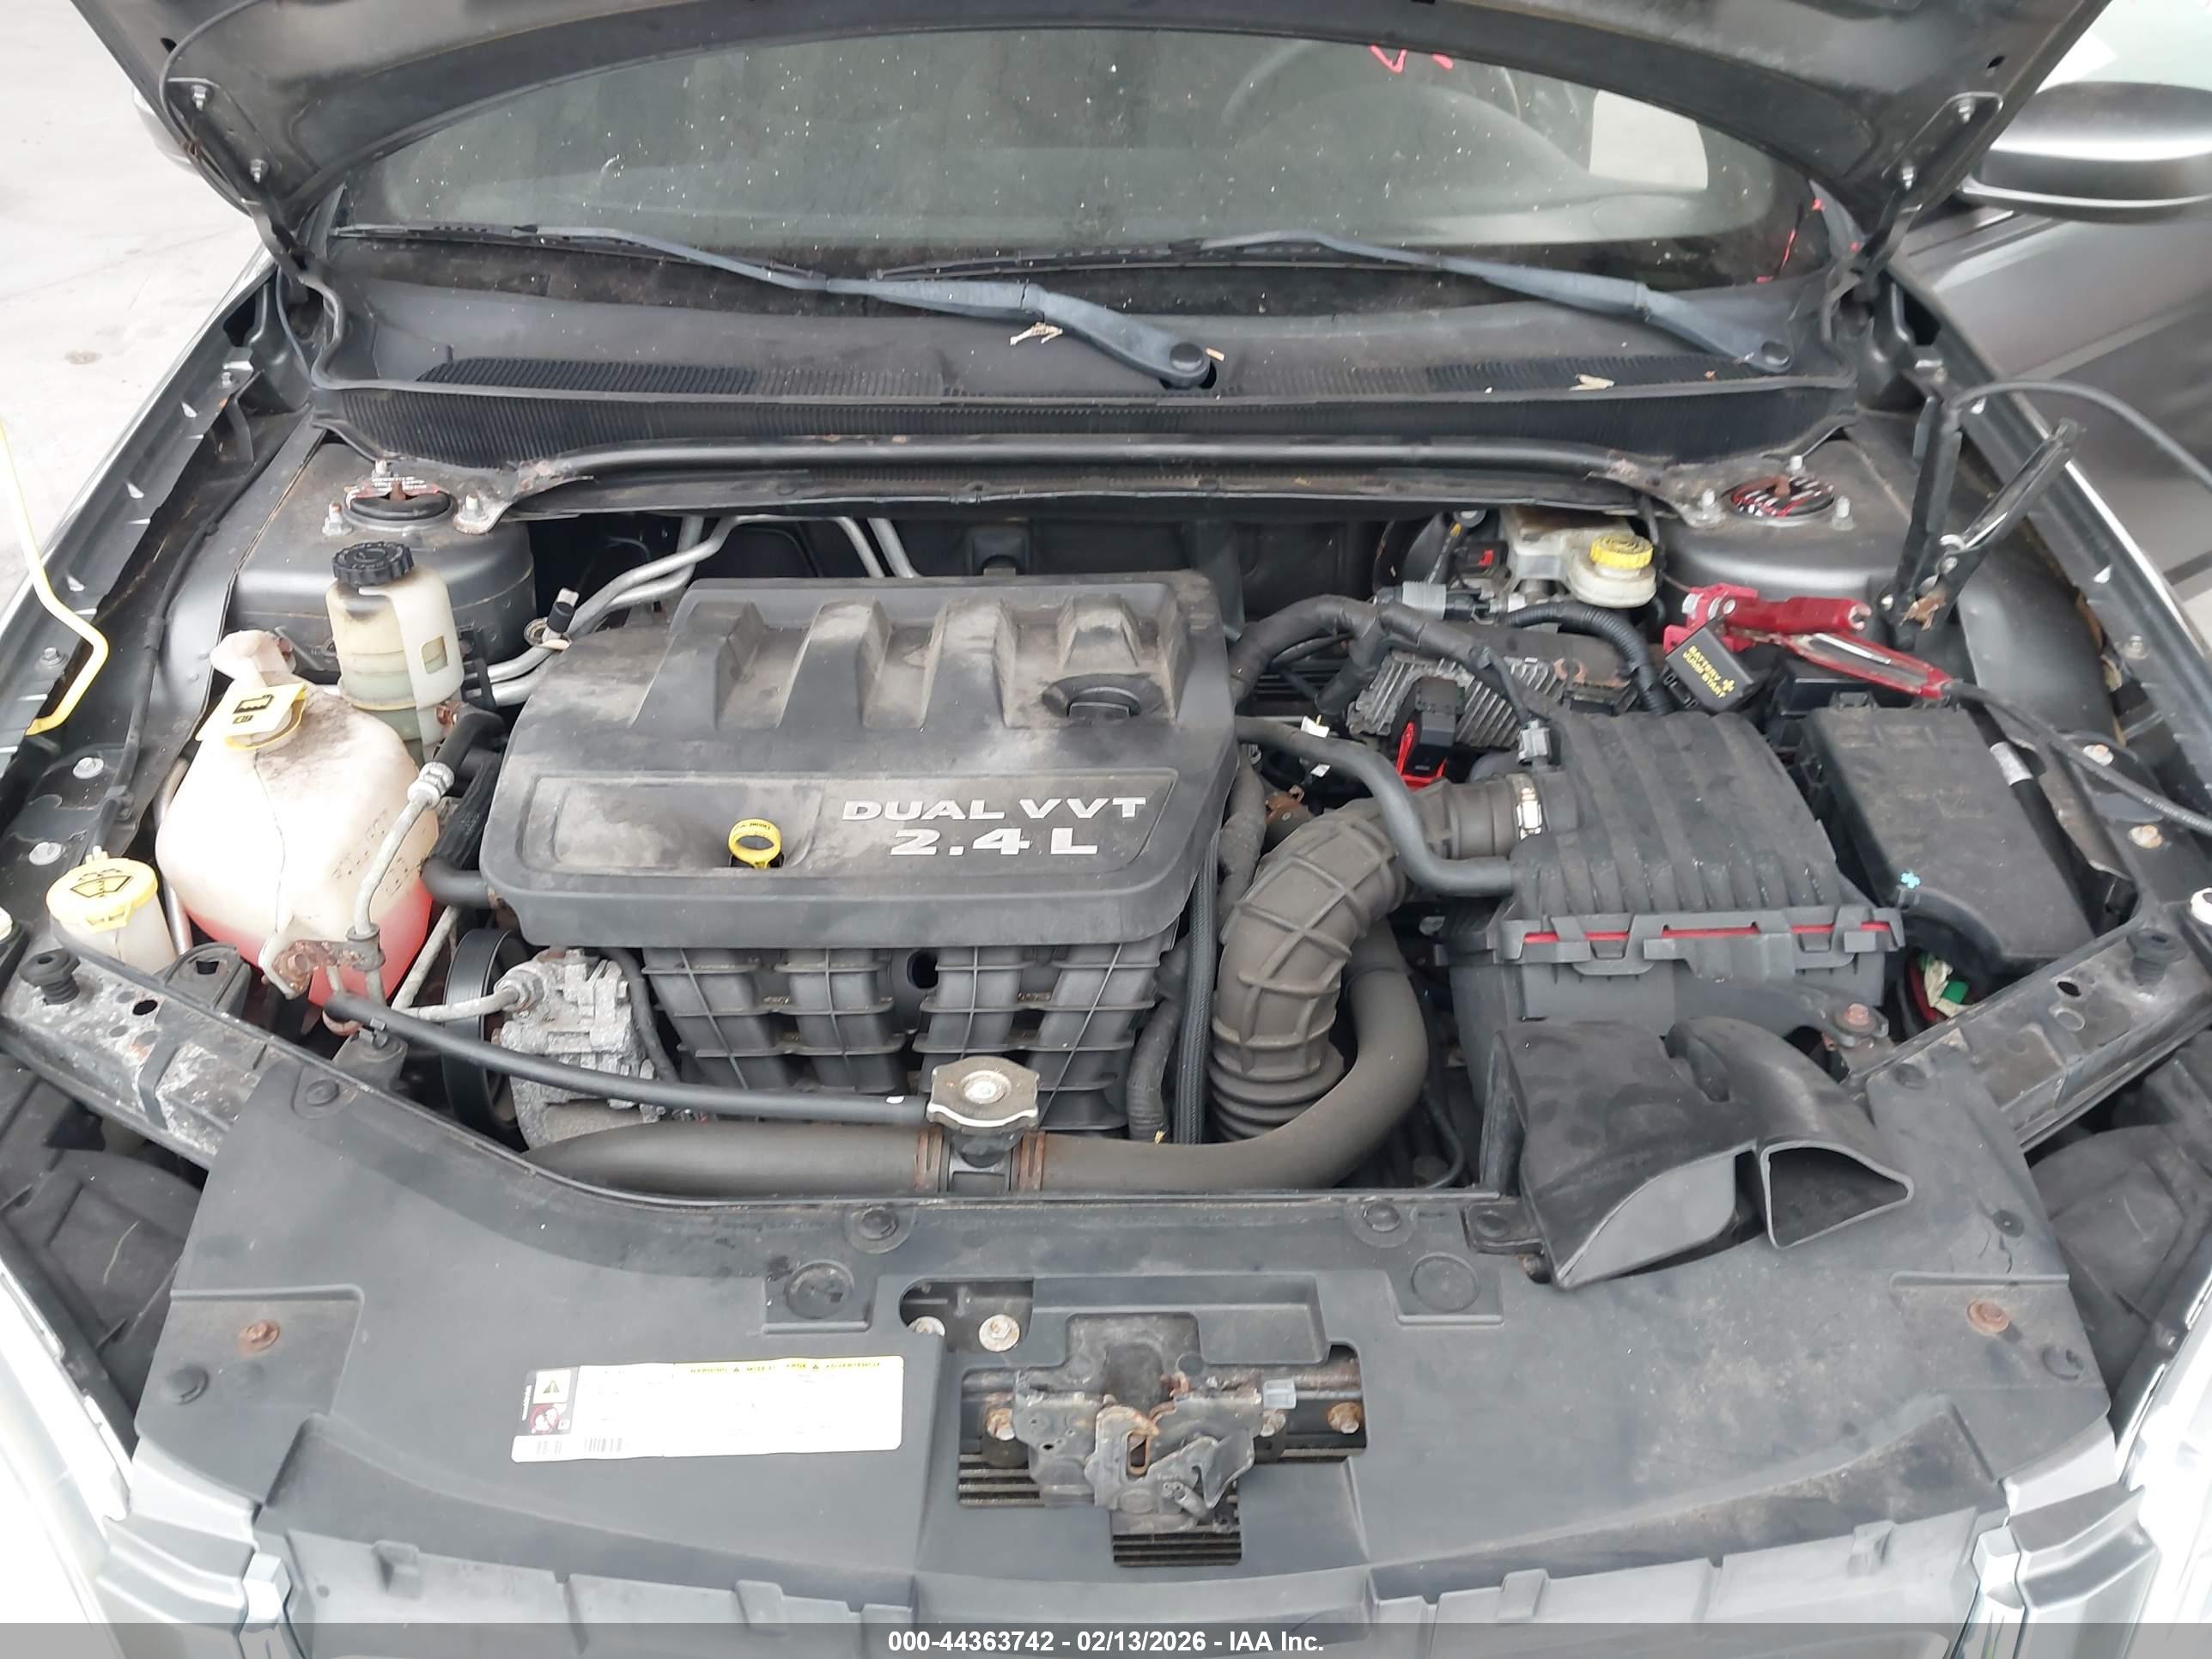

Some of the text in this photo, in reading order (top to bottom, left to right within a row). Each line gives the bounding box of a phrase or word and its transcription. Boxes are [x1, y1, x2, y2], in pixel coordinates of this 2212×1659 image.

[1682, 651, 1727, 698] JUMP START
[1688, 645, 1722, 681] BATTERY
[842, 797, 1146, 821] DUAL VVT
